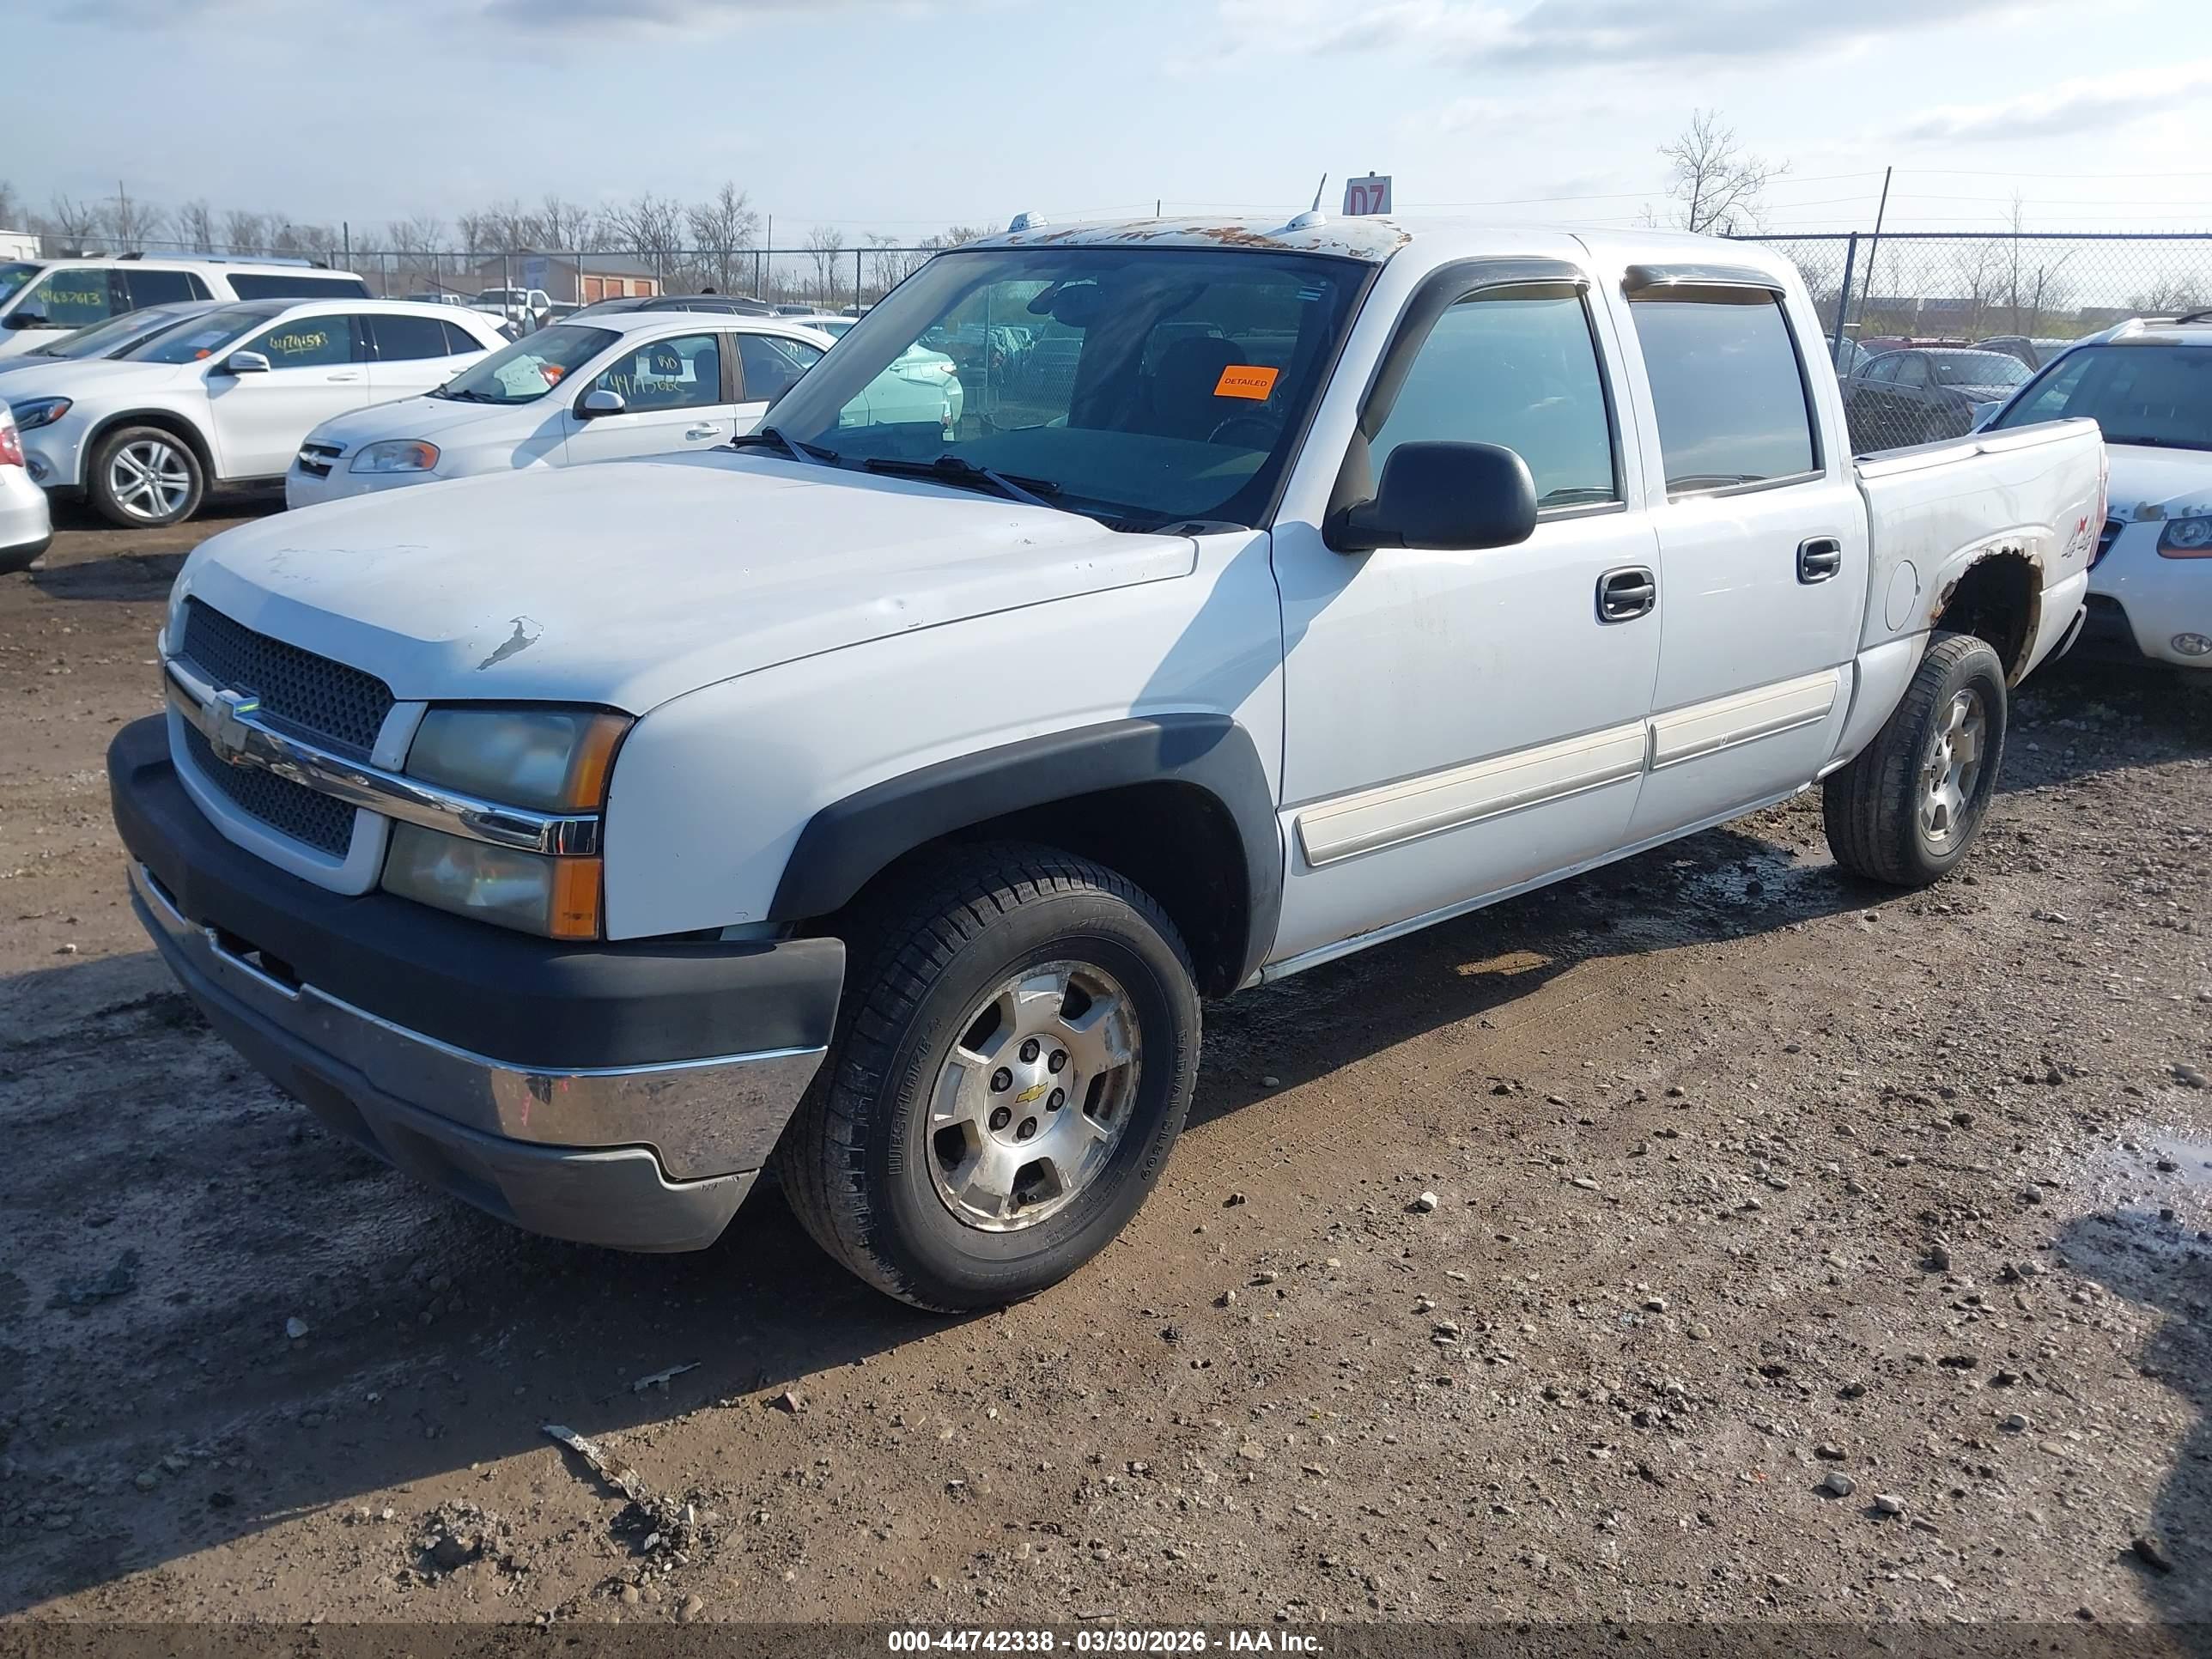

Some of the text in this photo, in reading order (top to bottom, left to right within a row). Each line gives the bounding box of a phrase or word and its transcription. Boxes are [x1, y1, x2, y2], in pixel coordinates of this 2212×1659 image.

[1350, 184, 1384, 216] D7
[1224, 378, 1267, 386] DETAILED
[888, 1036, 932, 1175] WESTLAKE
